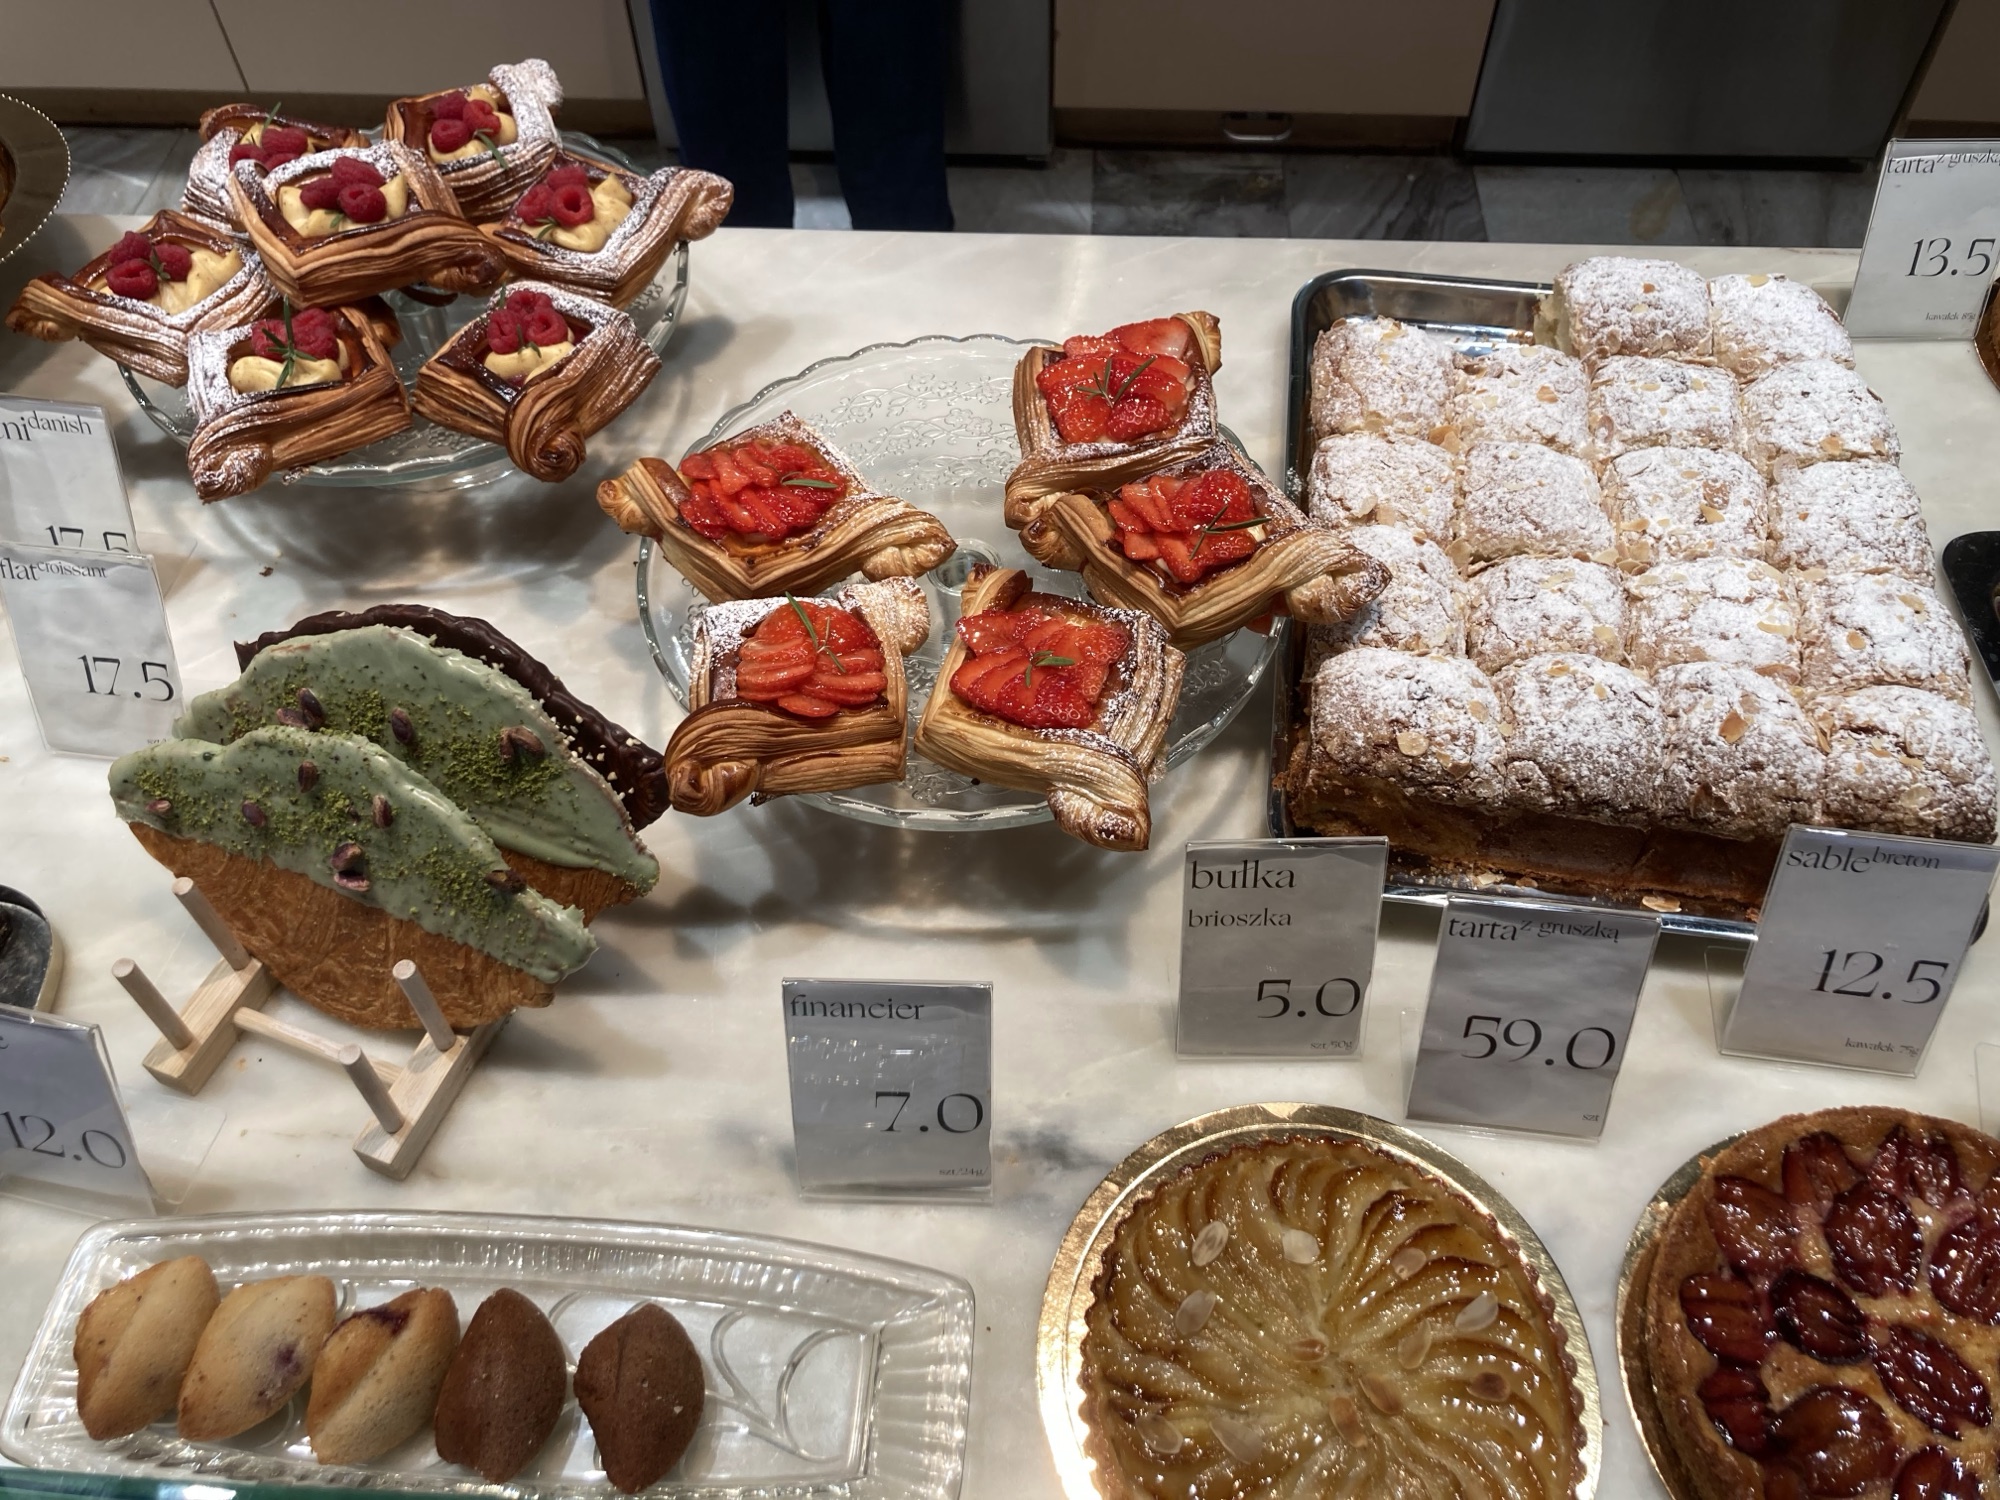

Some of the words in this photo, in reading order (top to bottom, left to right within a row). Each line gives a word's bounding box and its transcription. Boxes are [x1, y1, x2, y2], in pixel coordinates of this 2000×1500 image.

[1887, 157, 1935, 174] tarta
[1937, 153, 1946, 164] z
[1905, 238, 1996, 277] 13.5
[0, 416, 32, 441] ni
[27, 410, 93, 435] danish
[0, 557, 39, 581] flat
[37, 561, 107, 578] croissant
[77, 654, 175, 702] 17.5
[1190, 859, 1297, 889] bułka
[1786, 845, 1870, 873] sable
[1872, 846, 1940, 869] breton
[1188, 908, 1293, 928] brioszka
[1448, 917, 1519, 941] tarta
[1520, 920, 1533, 932] z
[1538, 920, 1620, 943] gruszką
[1810, 949, 1950, 1004] 12.5
[790, 994, 925, 1020] financier
[1257, 977, 1361, 1019] 5.0
[1460, 1014, 1616, 1070] 59.0
[875, 1091, 984, 1134] 7.0
[0, 1111, 126, 1169] 12.0
